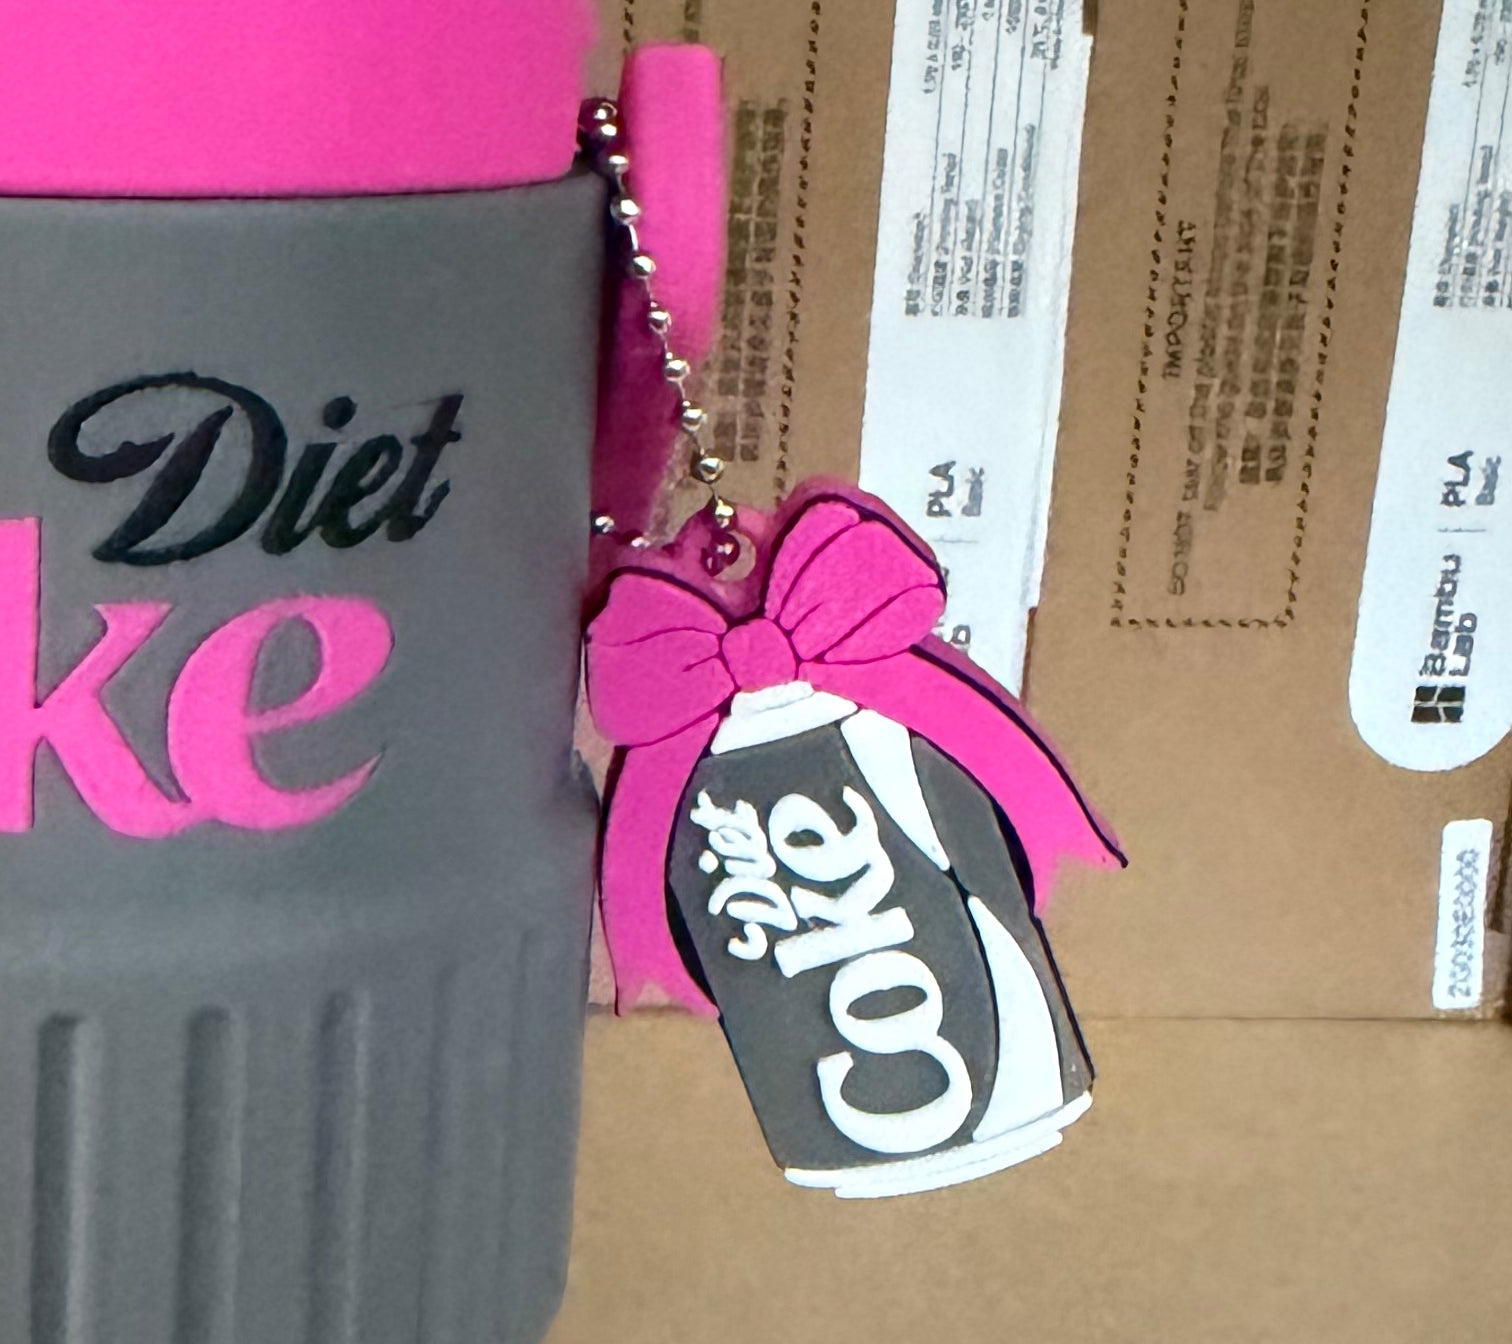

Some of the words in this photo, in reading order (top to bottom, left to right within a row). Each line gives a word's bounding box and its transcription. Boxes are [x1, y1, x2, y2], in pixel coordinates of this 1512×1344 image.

[47, 370, 465, 568] Diet
[926, 460, 958, 518] PLA
[1440, 450, 1475, 508] PLA
[1418, 553, 1463, 678] Bambu
[1448, 612, 1479, 677] Lab
[690, 788, 797, 962] Diet
[774, 786, 975, 1155] Coke
